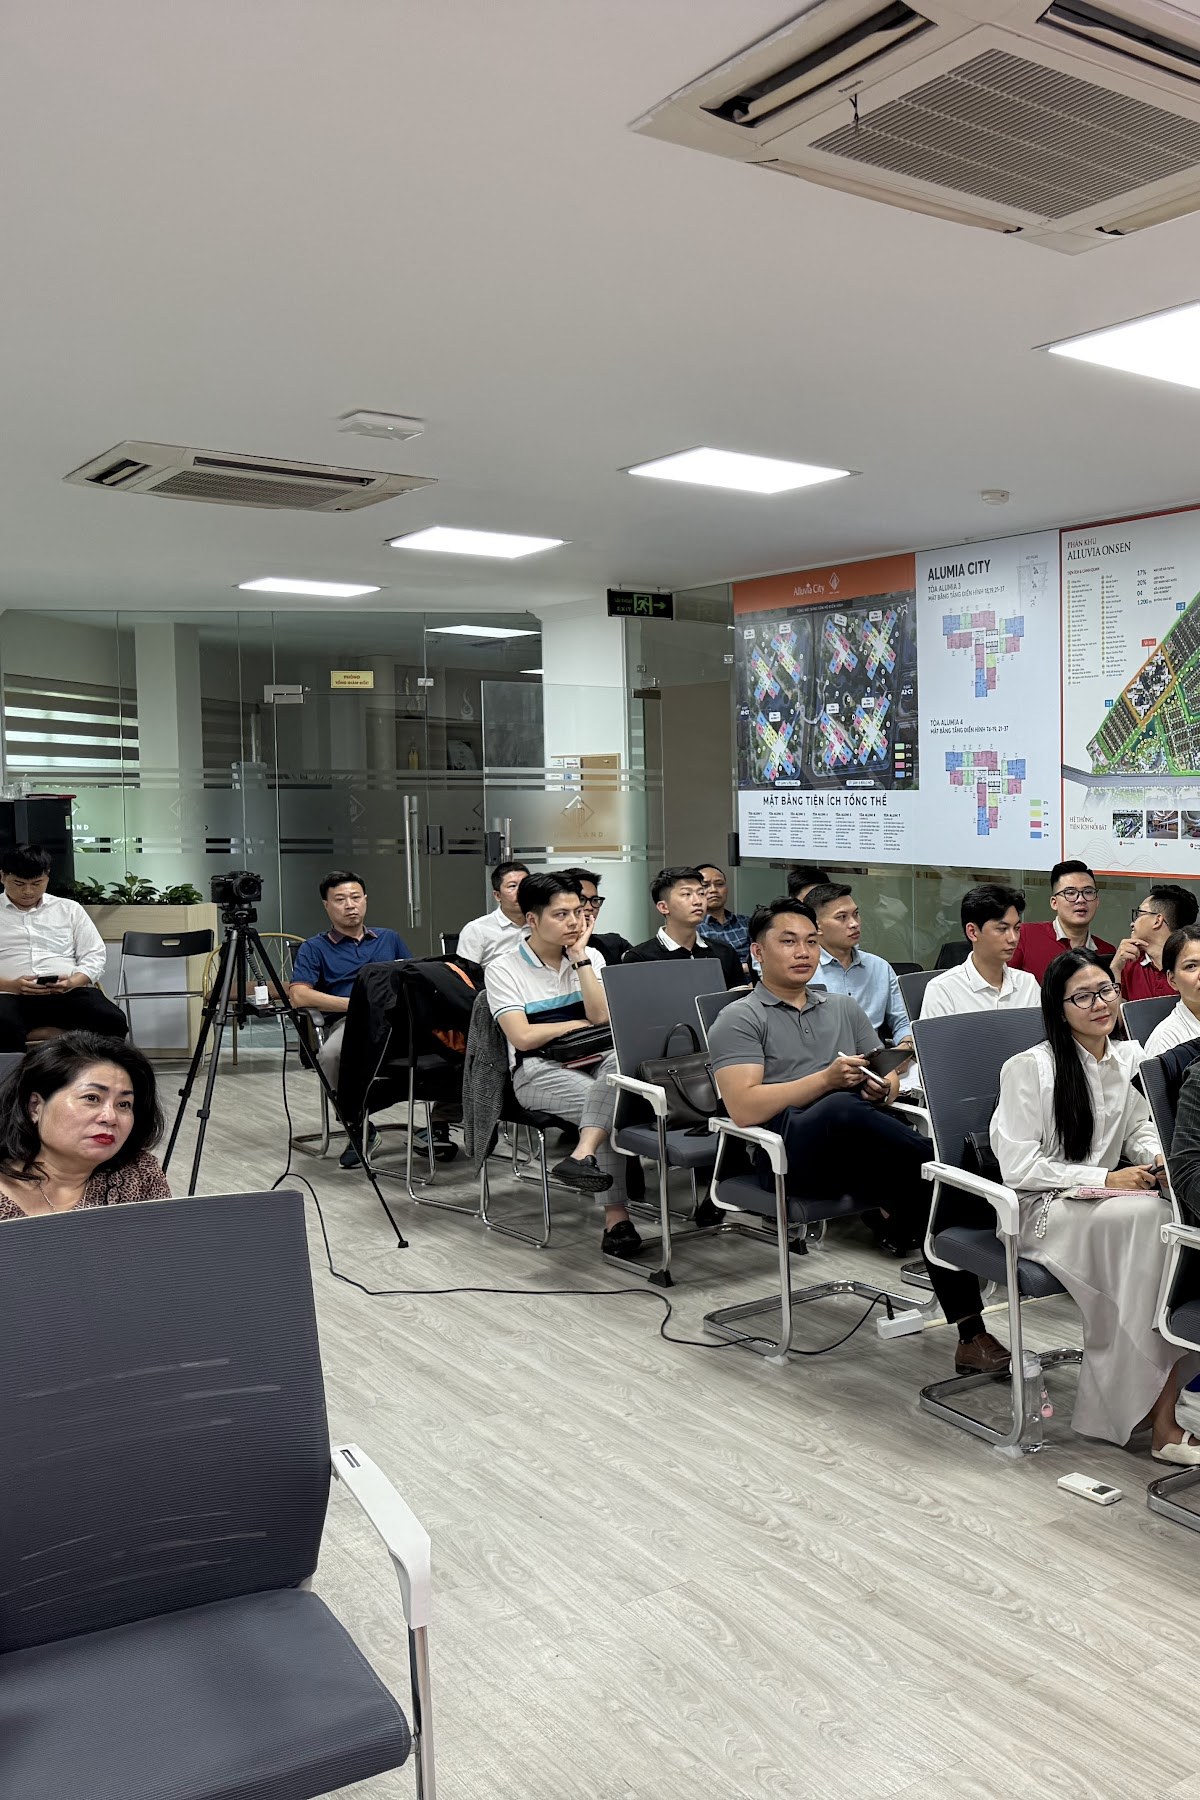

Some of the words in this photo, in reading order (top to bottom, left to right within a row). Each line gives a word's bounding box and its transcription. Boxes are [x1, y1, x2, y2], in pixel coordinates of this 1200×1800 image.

[1084, 537, 1097, 547] KHU
[1067, 547, 1101, 560] ALLUVIA
[1101, 541, 1131, 555] ONSEN
[927, 563, 965, 581] ALUMIA
[967, 559, 991, 576] CITY
[1137, 569, 1147, 577] 17%
[928, 585, 938, 594] TÒA
[939, 583, 957, 592] ALUMIA
[1137, 579, 1147, 587] 20%
[793, 583, 813, 597] Alluvia
[812, 583, 825, 596] City
[930, 718, 940, 727] TÒA
[940, 718, 960, 726] ALUMIA
[763, 794, 779, 808] MẶT
[781, 792, 803, 806] BẰNG
[805, 793, 824, 808] TIỆN
[826, 793, 841, 806] ÍCH
[844, 793, 868, 806] TỔNG
[870, 792, 887, 806] THỂ
